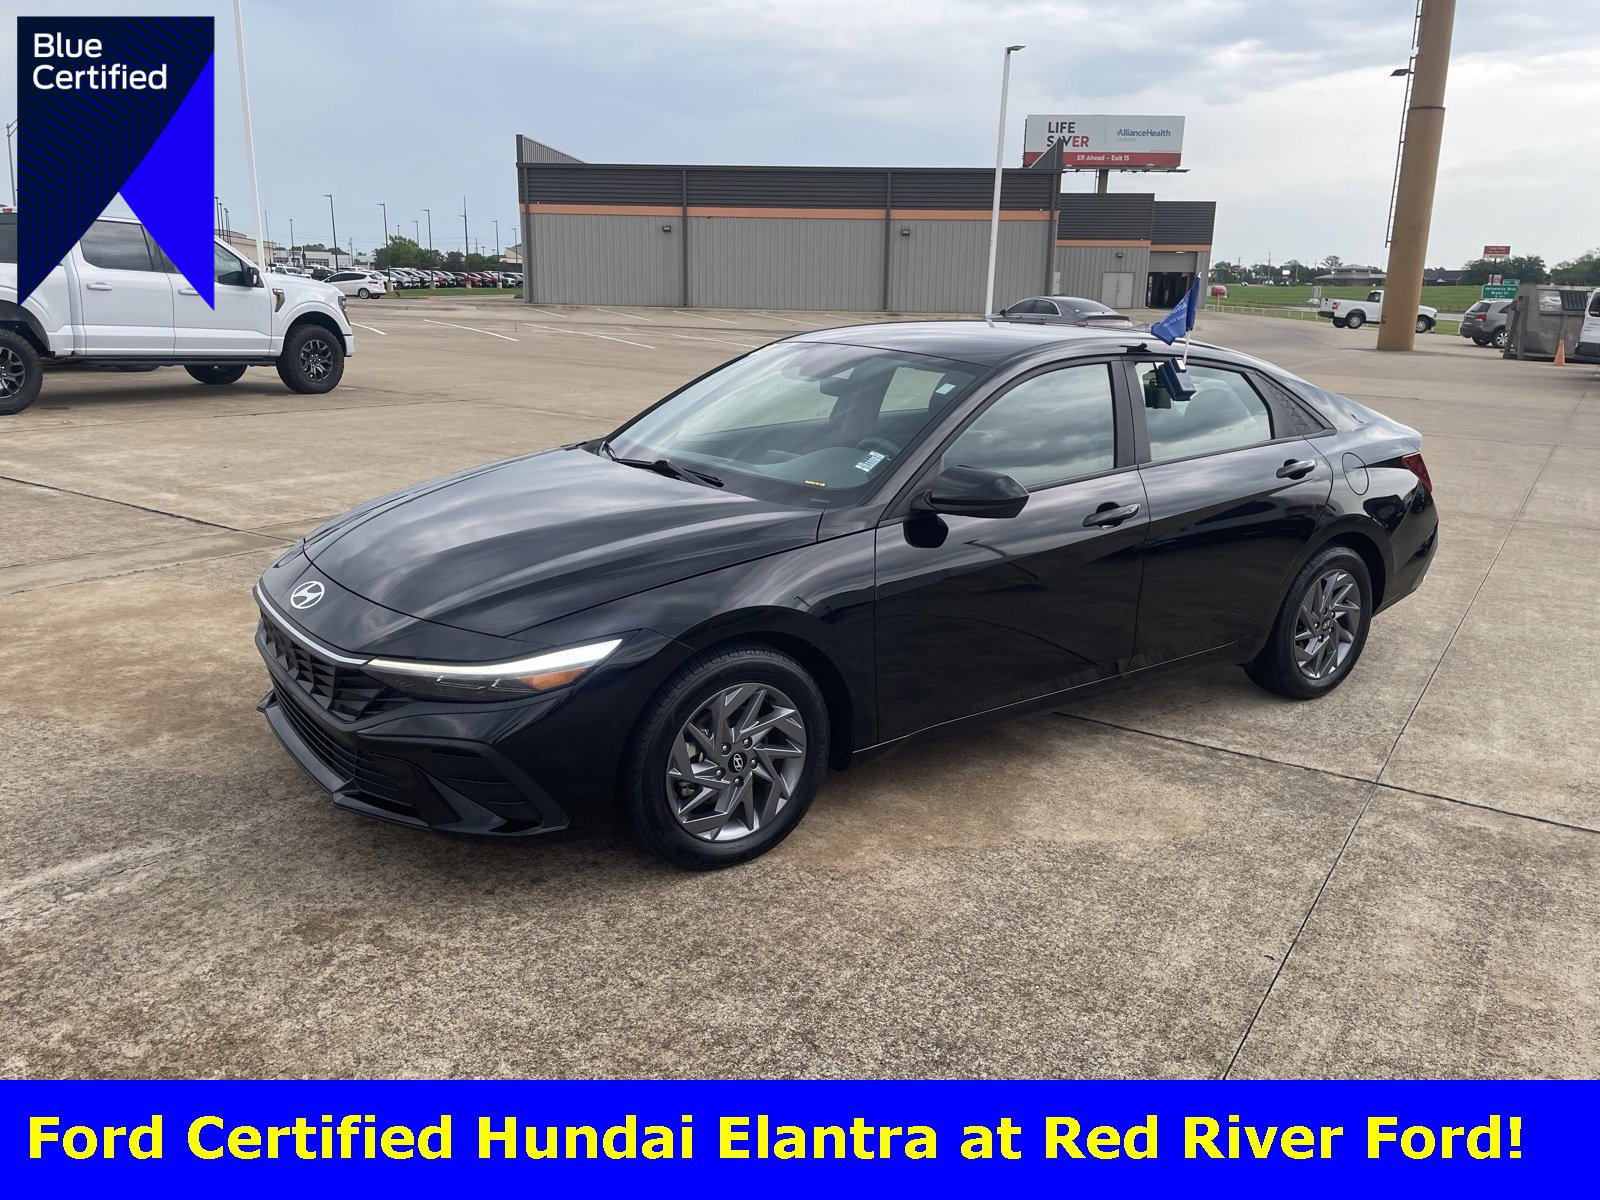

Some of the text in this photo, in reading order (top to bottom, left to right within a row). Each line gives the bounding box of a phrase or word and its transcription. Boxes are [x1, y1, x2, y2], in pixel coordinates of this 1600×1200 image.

[1048, 122, 1076, 134] LIFE
[1117, 128, 1171, 137] AllianceHealth
[1047, 135, 1089, 147] SVER
